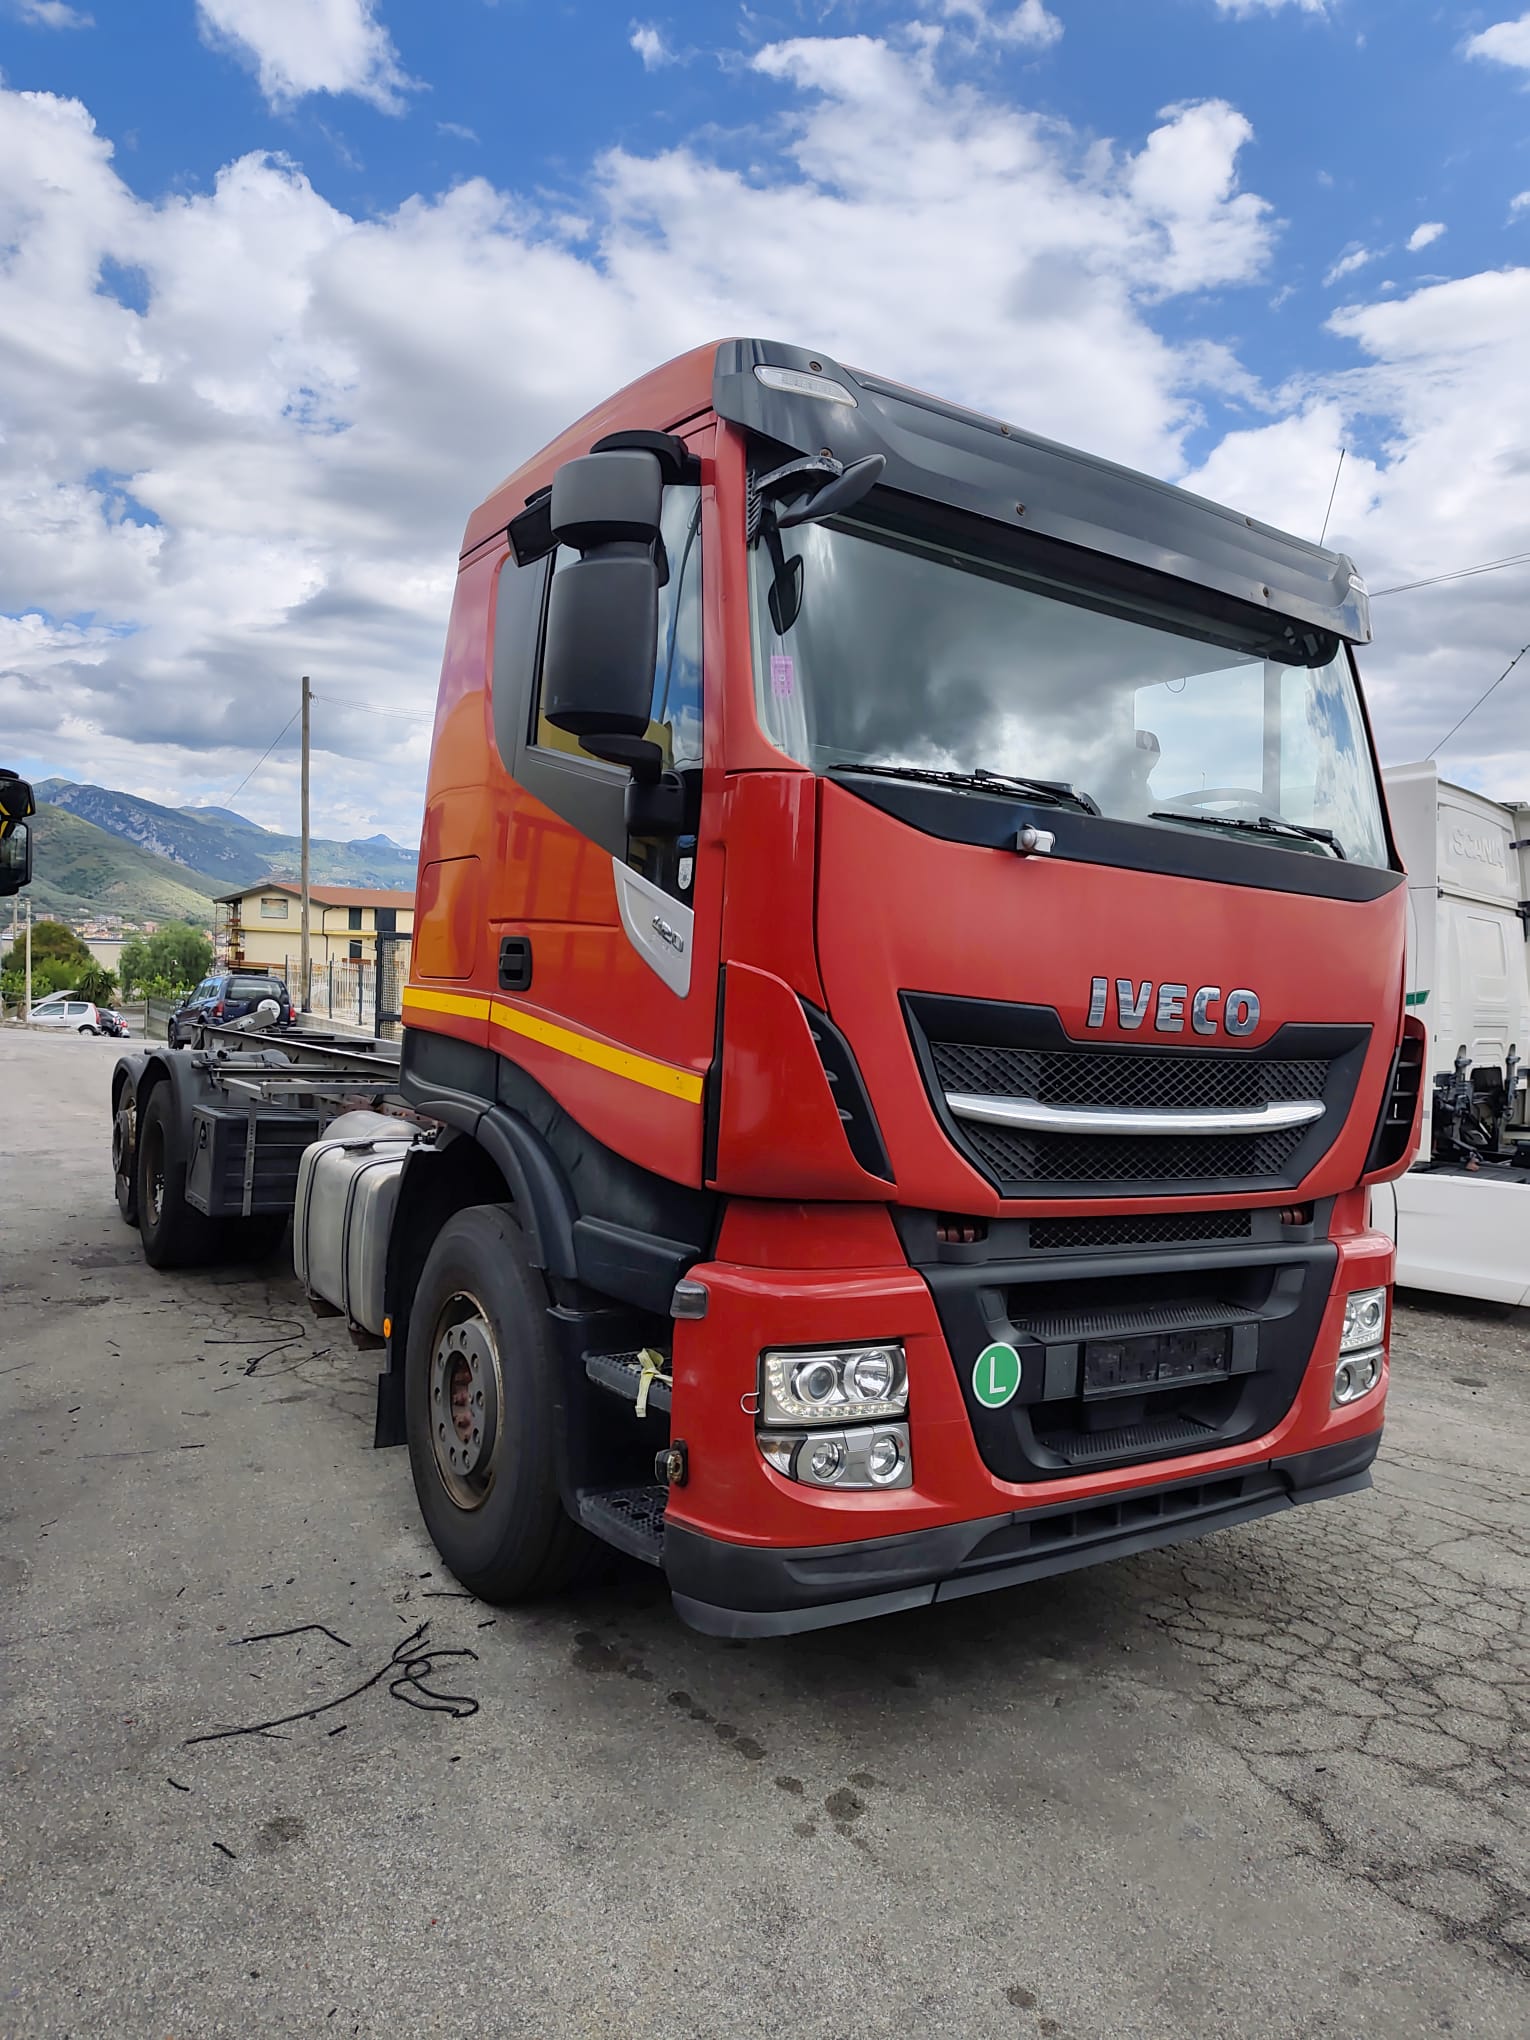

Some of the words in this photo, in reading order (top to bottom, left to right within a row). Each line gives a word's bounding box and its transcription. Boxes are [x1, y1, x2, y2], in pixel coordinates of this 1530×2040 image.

[1451, 828, 1504, 869] SCANIA
[652, 915, 684, 952] 420
[1086, 976, 1261, 1037] IVECO
[989, 1356, 1007, 1394] L
